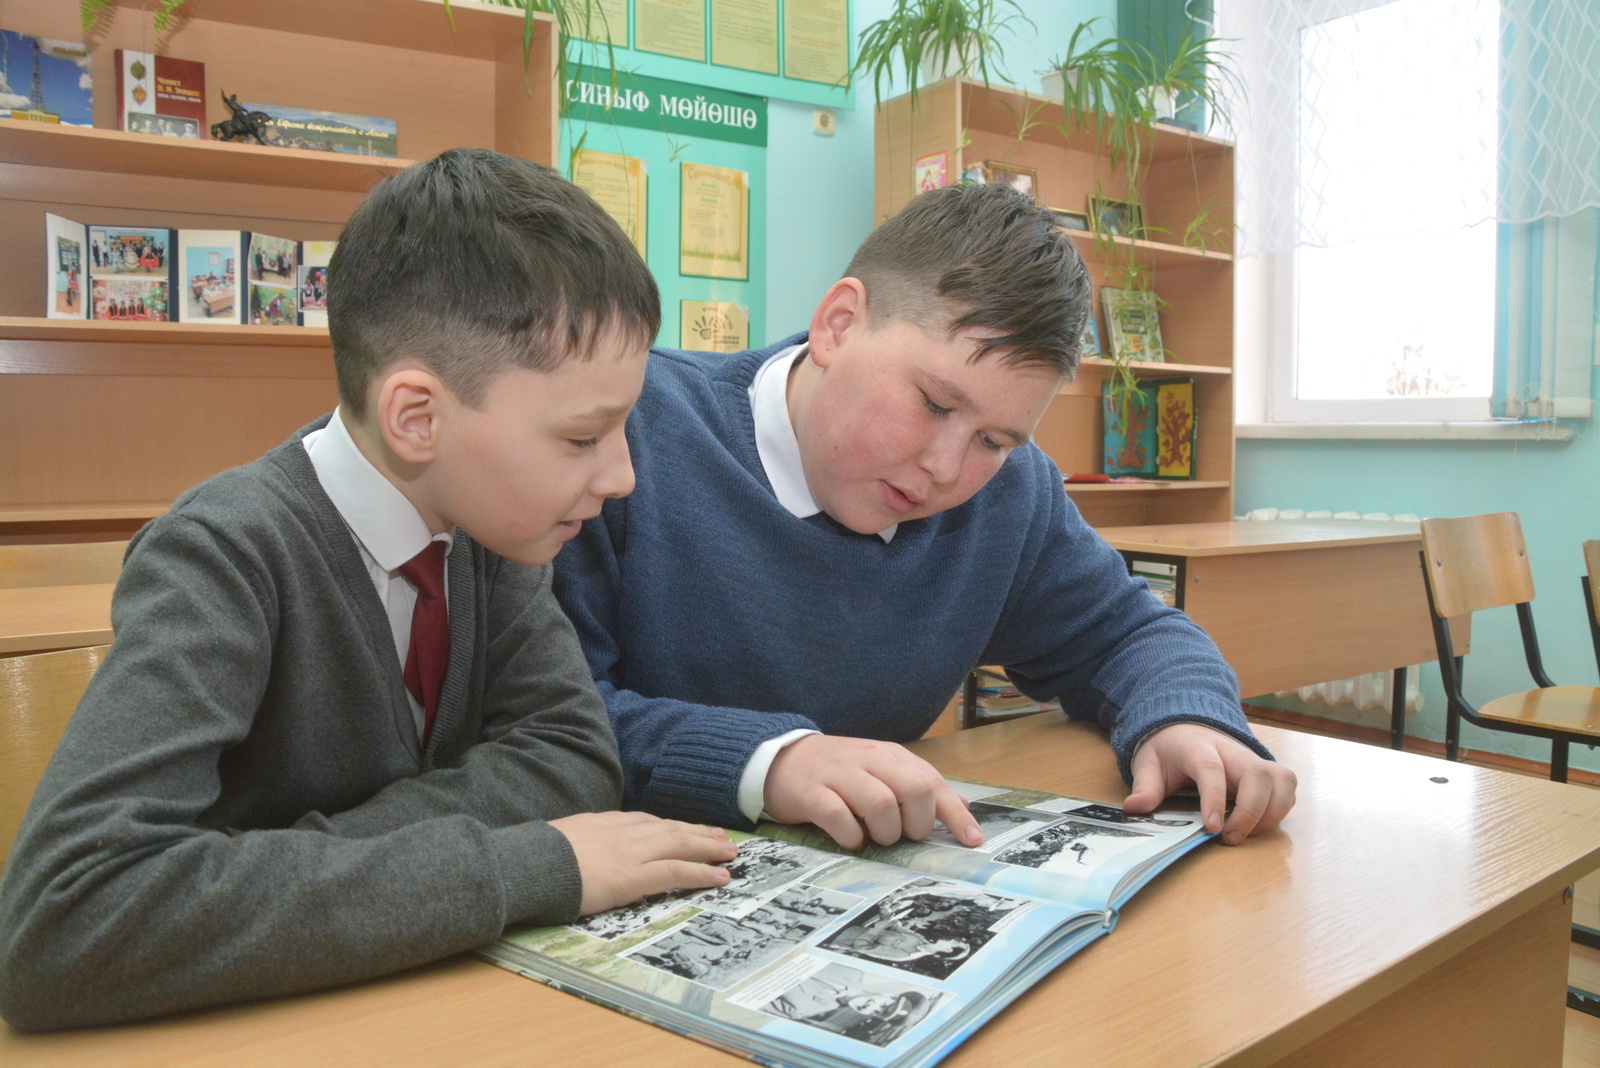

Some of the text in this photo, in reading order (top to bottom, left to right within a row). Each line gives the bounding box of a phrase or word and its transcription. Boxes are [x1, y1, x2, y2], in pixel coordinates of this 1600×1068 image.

[566, 79, 757, 129] СИНЫФ МӨЙӨШӨ
[277, 118, 305, 129] Европа
